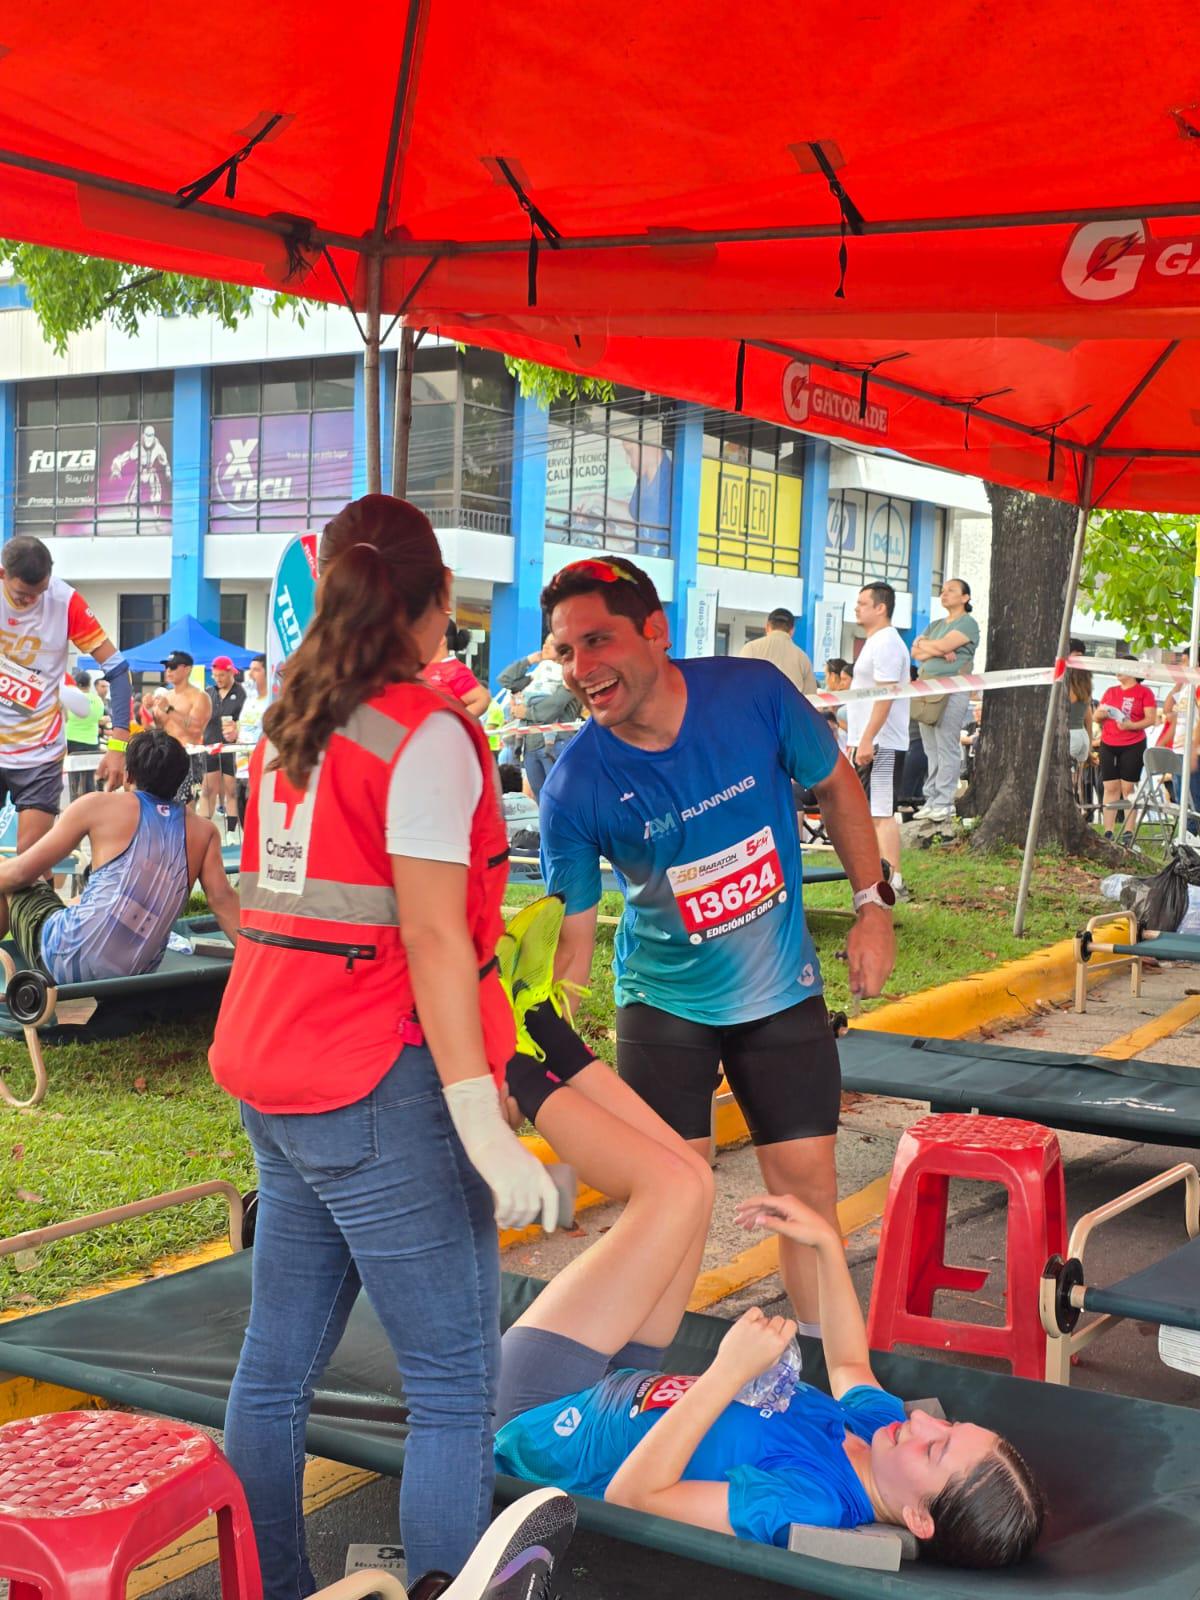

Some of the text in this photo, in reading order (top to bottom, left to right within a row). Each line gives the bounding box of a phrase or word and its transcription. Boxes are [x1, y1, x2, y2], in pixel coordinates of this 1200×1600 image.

[28, 449, 97, 474] forza
[546, 465, 607, 482] CALIICADO
[231, 477, 292, 500] TECH
[680, 775, 756, 822] RUNNING
[685, 861, 777, 924] 13624
[706, 898, 774, 939] EDICIÓN DE ORO
